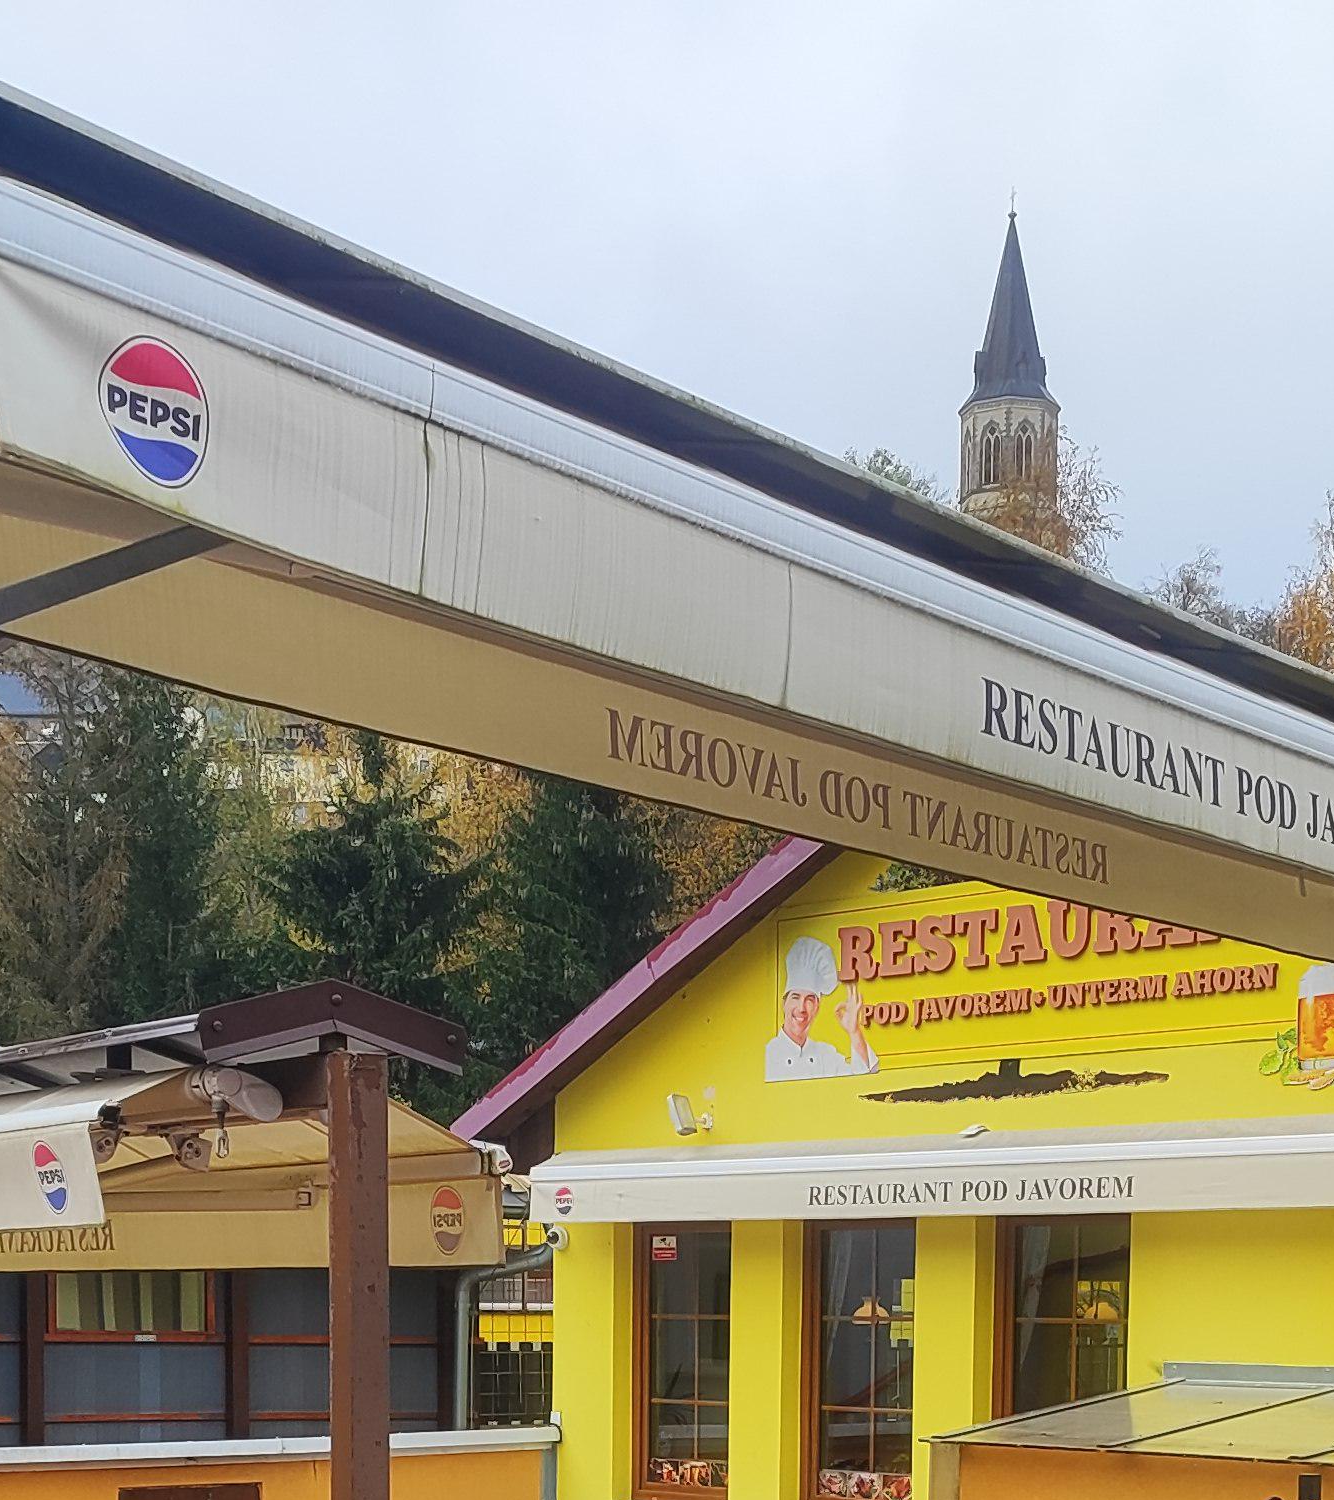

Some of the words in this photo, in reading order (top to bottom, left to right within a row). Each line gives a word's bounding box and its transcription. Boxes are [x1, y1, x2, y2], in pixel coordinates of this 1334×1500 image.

[107, 382, 202, 442] PEPSI
[980, 676, 1226, 808] RESTAURANT
[1235, 765, 1297, 831] POD
[861, 1000, 910, 1028] POD
[912, 987, 1033, 1029] JAVOREM
[1047, 974, 1167, 1010] UNTERM
[1171, 962, 1280, 999] AHORN
[37, 1168, 65, 1186] PEPSI
[807, 1180, 954, 1206] RESTAURANT
[960, 1179, 1008, 1202] POD
[1015, 1175, 1135, 1201] JAVOREM
